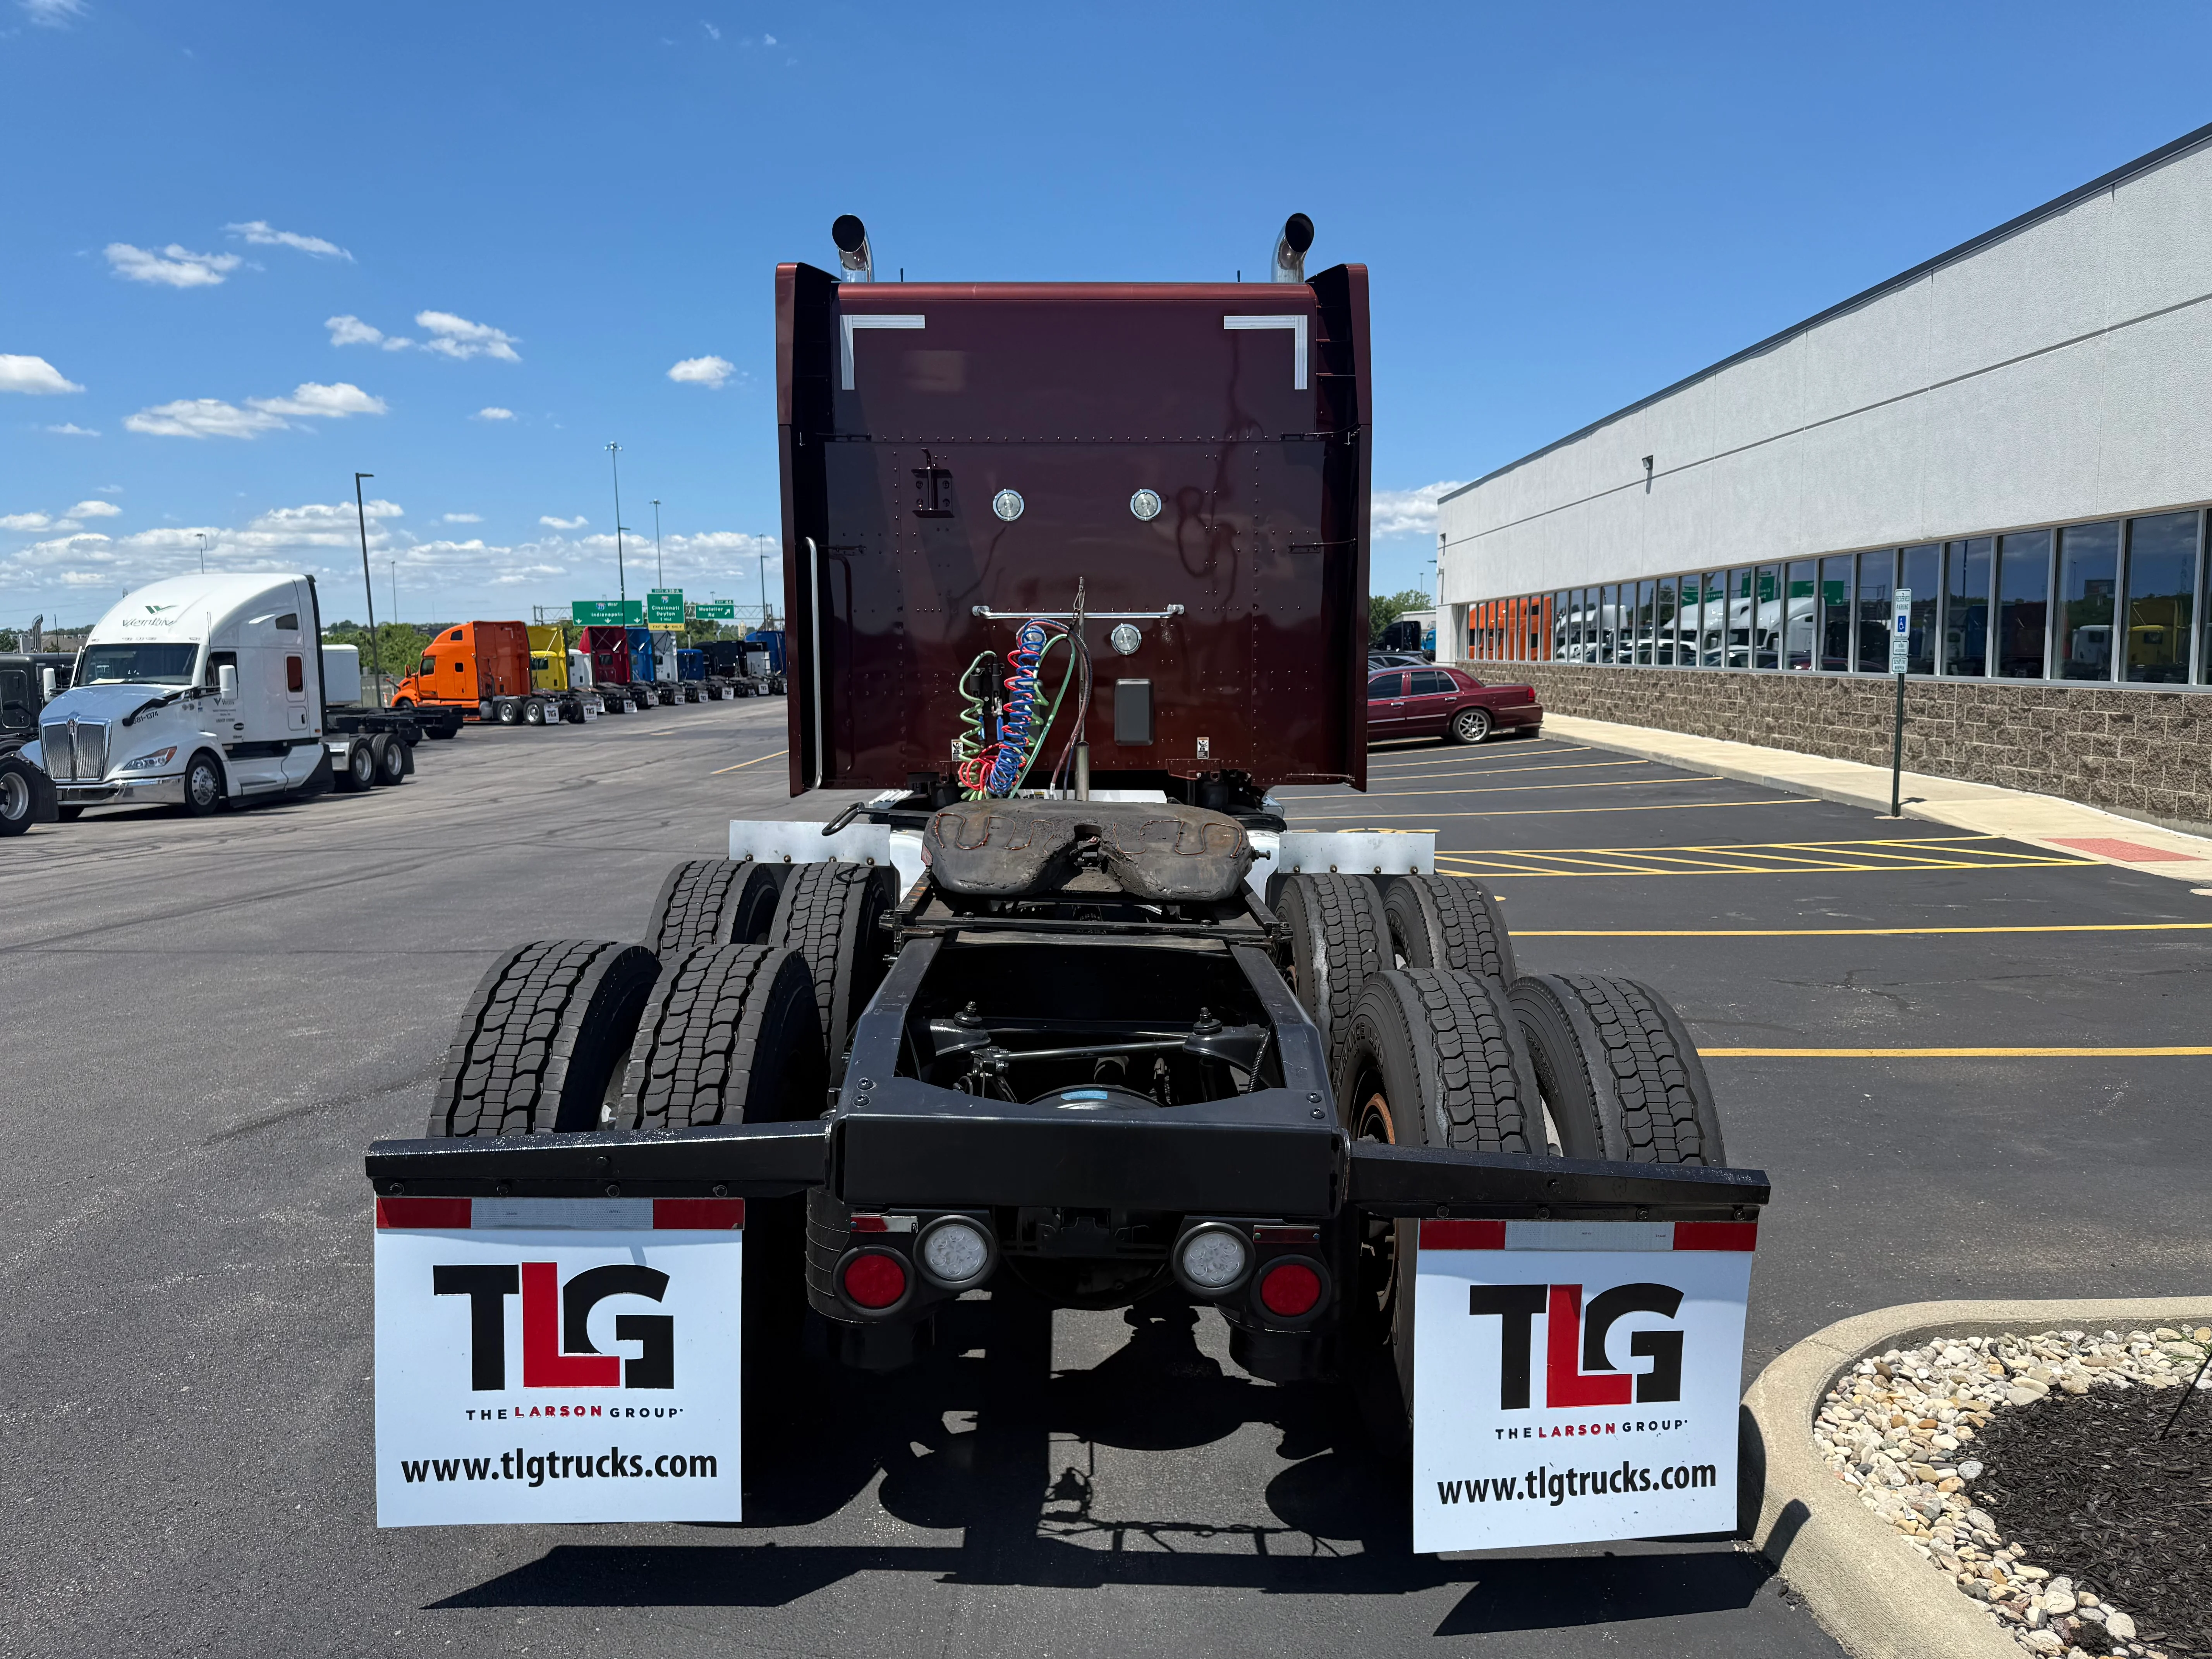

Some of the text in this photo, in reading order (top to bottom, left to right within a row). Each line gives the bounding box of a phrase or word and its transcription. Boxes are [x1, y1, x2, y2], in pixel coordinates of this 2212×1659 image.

[433, 1262, 674, 1391] TLG
[1470, 1283, 1684, 1410] TLG
[466, 1405, 678, 1420] THE LARSON GROUP
[1495, 1420, 1683, 1440] THE LARSON GROUP
[401, 1446, 717, 1487] www.tlgtrucks.com
[1437, 1461, 1716, 1506] www.tlgtrucks.com
